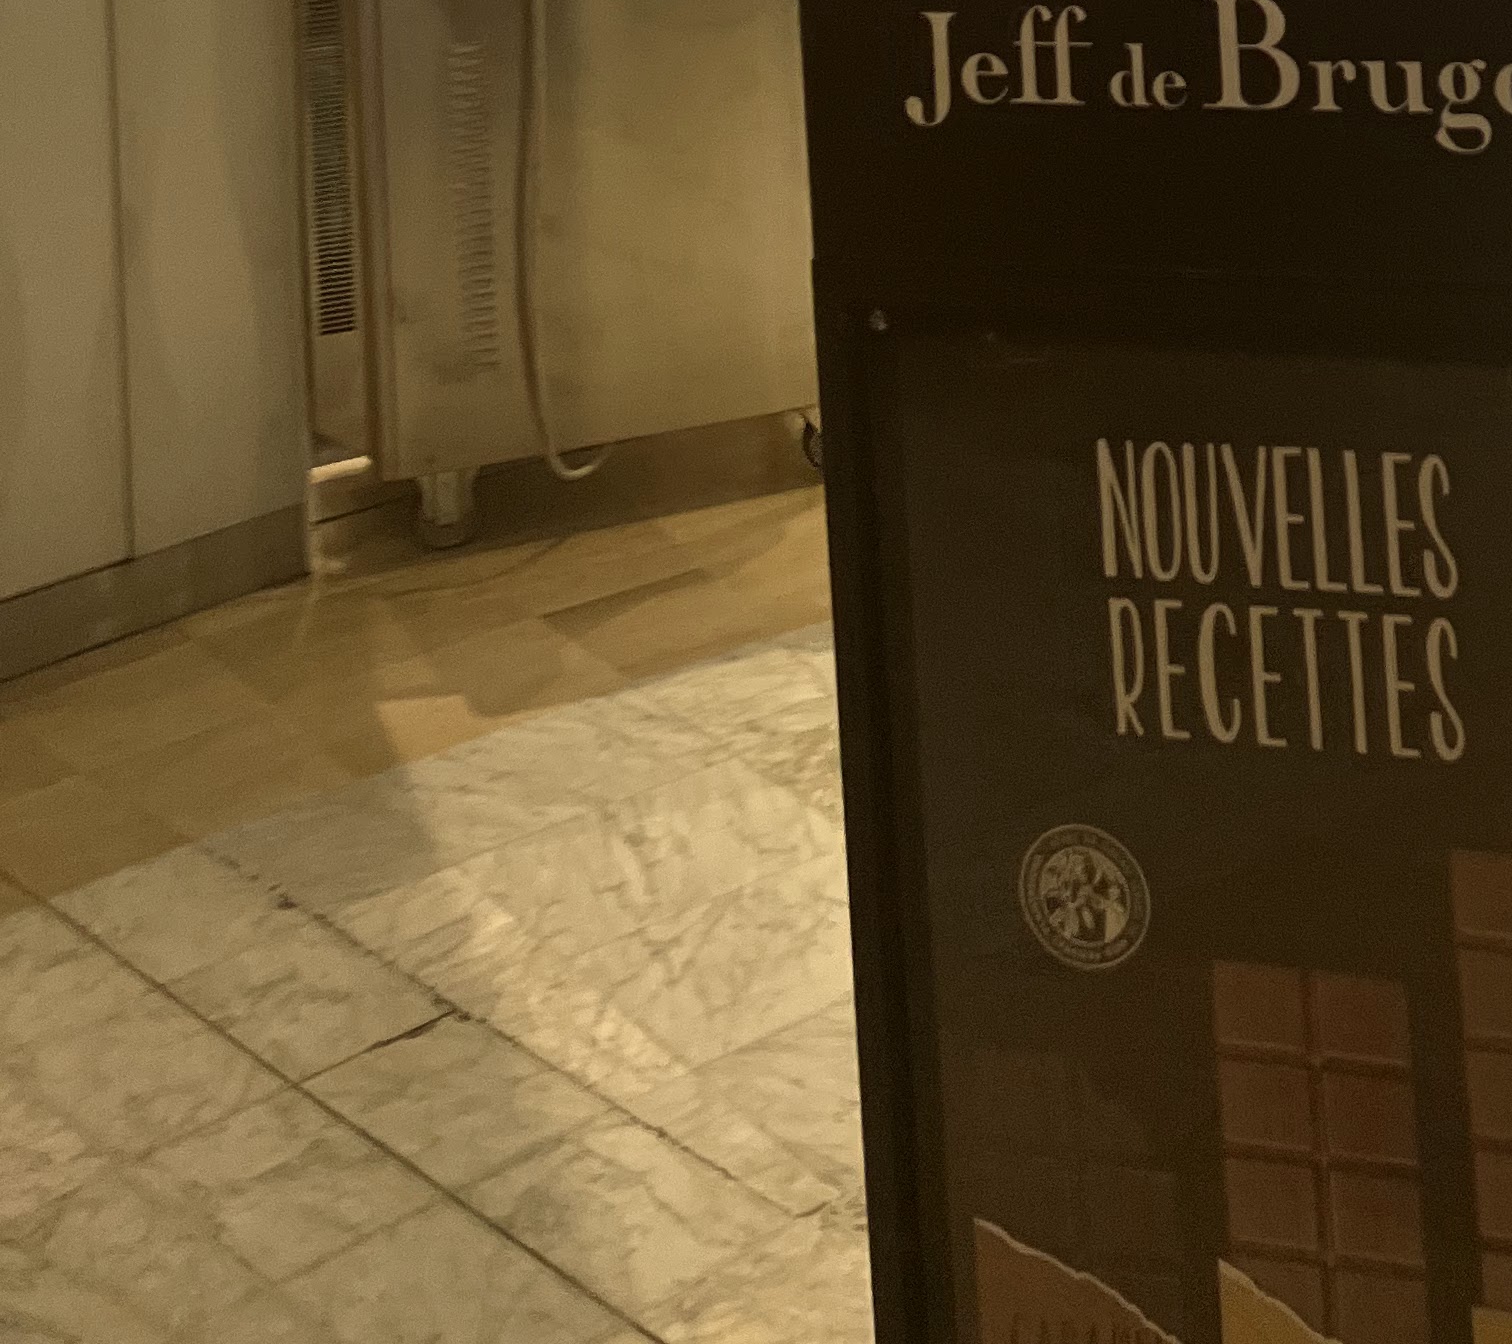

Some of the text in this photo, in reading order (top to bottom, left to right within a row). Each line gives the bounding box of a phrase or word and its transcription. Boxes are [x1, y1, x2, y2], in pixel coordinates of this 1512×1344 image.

[903, 3, 1094, 127] Jeff
[1109, 42, 1189, 108] de
[1096, 437, 1459, 599] NOUVELLES
[1107, 596, 1466, 762] RECETTES
